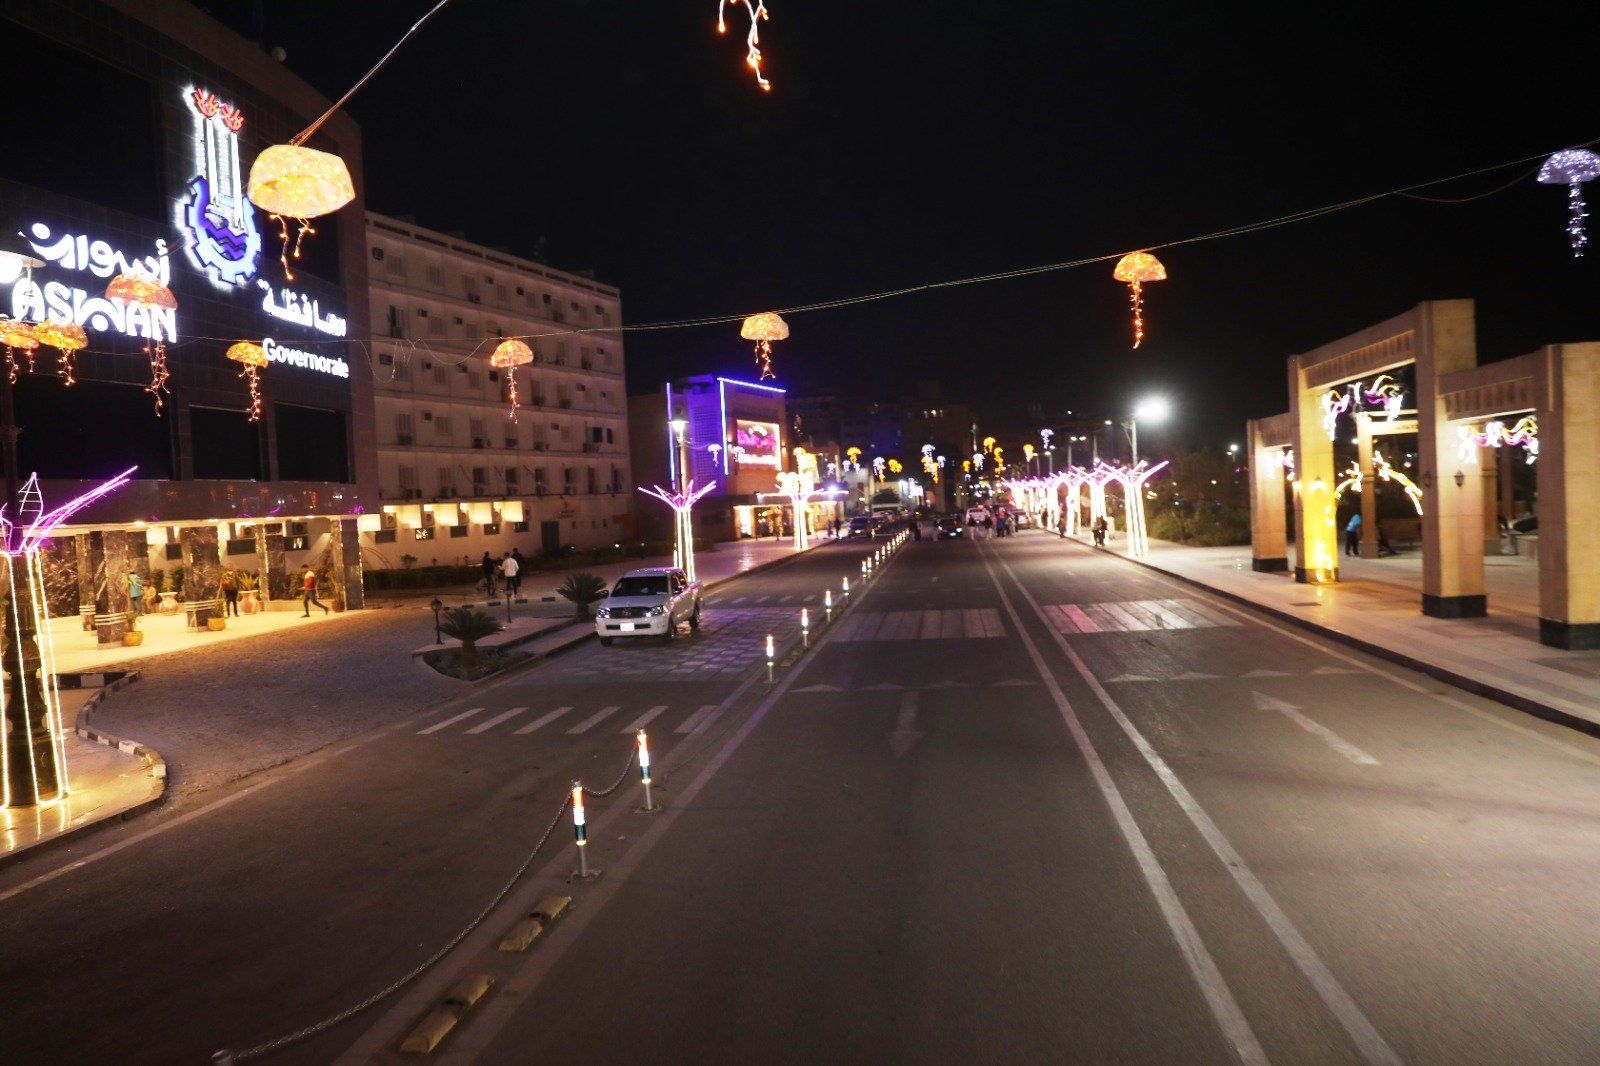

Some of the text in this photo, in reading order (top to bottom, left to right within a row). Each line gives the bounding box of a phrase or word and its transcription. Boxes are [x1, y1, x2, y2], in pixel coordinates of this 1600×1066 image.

[12, 277, 177, 344] ASWAN
[257, 278, 347, 337] محافظة
[263, 338, 349, 378] Governorate
